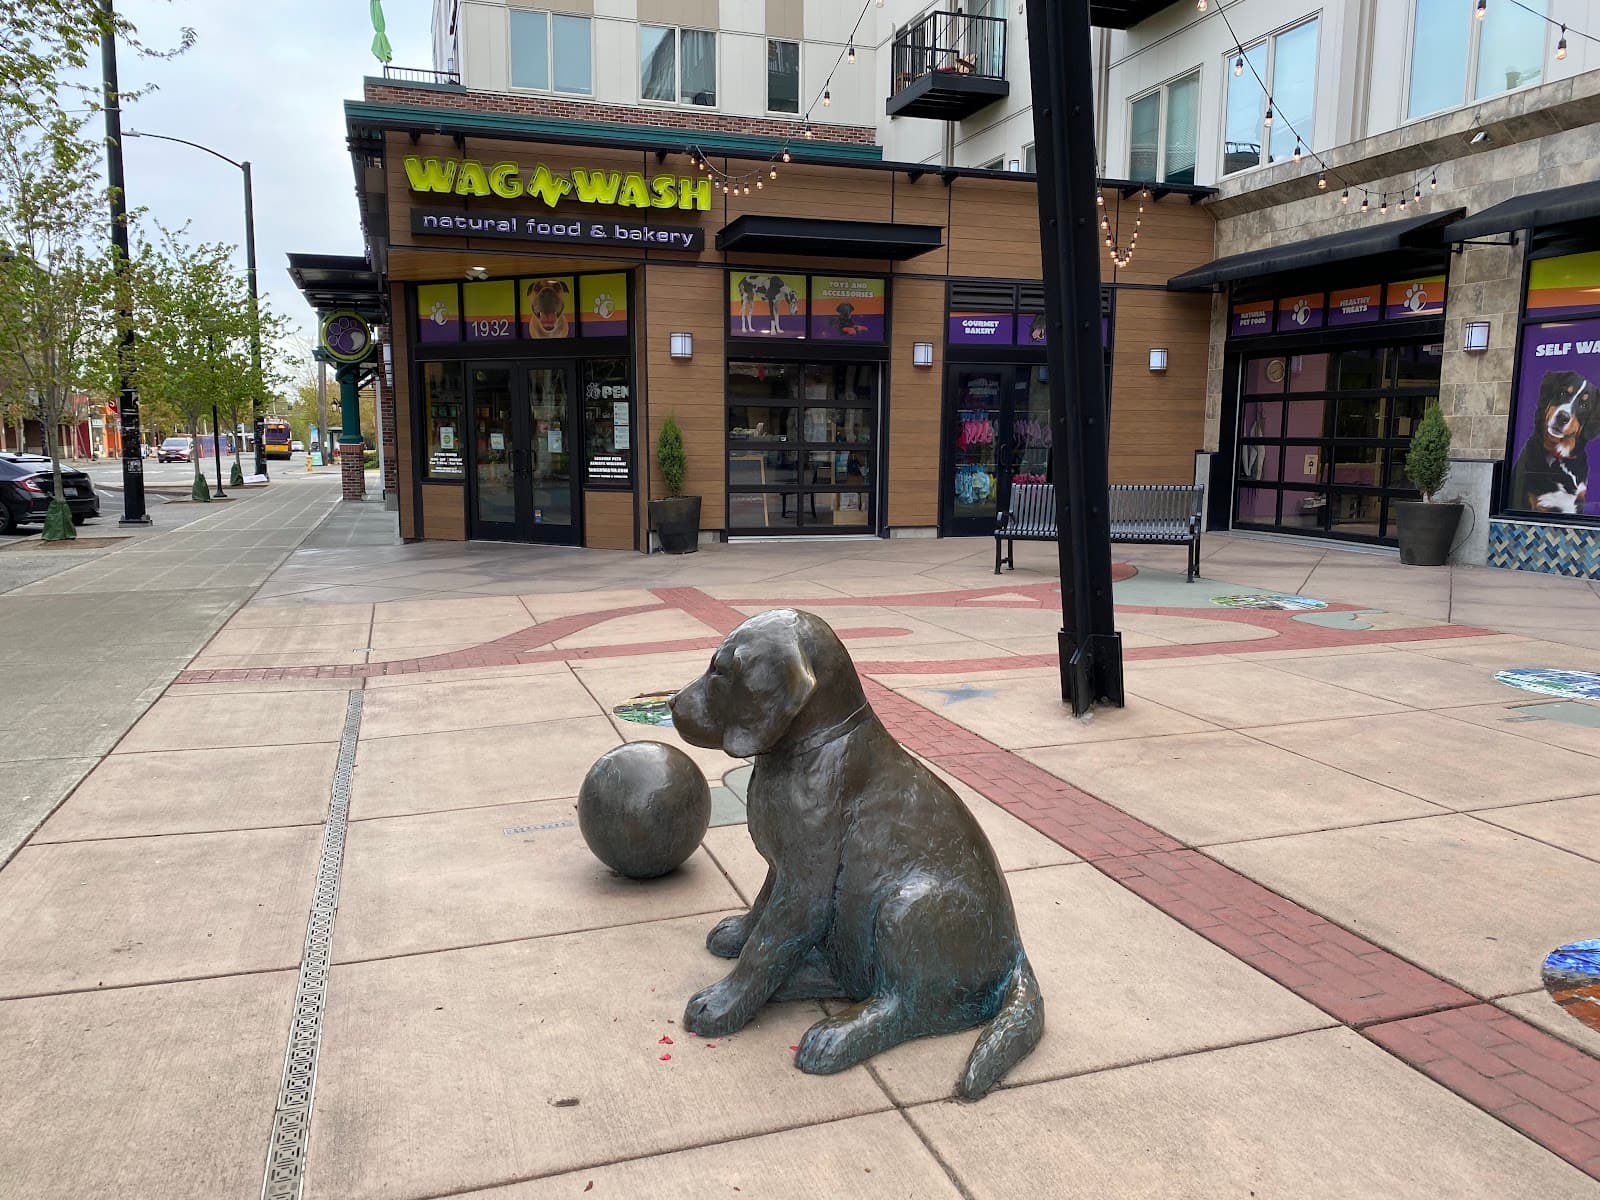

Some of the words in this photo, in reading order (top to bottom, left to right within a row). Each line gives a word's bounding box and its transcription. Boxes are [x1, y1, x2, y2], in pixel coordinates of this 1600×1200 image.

[403, 155, 523, 199] WAG
[571, 166, 712, 212] WASH
[423, 215, 517, 233] natural
[526, 218, 581, 238] food
[590, 224, 607, 238] &
[614, 224, 694, 248] bakery
[829, 281, 848, 289] TOYS
[822, 289, 874, 298] ACCESSORIES
[1340, 296, 1370, 307] HEALTHY
[1342, 305, 1368, 314] TREATS
[1240, 310, 1265, 319] NATURAL
[962, 319, 999, 328] GOURMET
[1239, 319, 1251, 327] PET
[1250, 317, 1267, 325] FOOD
[471, 319, 509, 338] 1932
[965, 327, 996, 335] BAKERY
[1535, 342, 1572, 357] SELF
